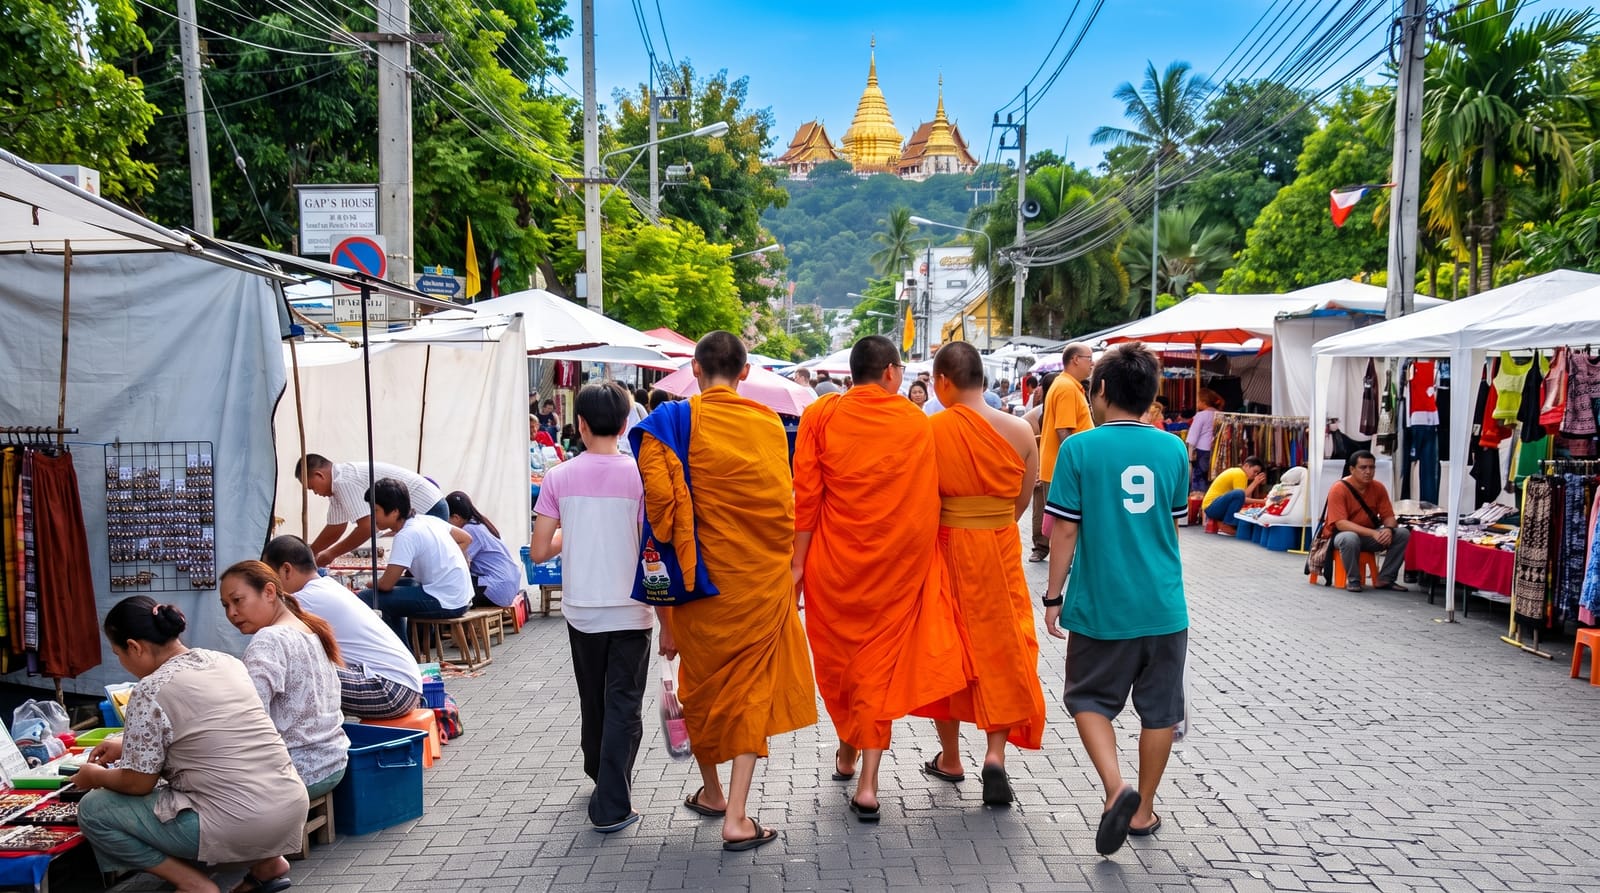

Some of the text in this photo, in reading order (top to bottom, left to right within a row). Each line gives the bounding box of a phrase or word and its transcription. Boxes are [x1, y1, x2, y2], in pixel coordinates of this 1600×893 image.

[304, 198, 375, 208] GAP'S HOUSE
[1121, 465, 1155, 514] 9
